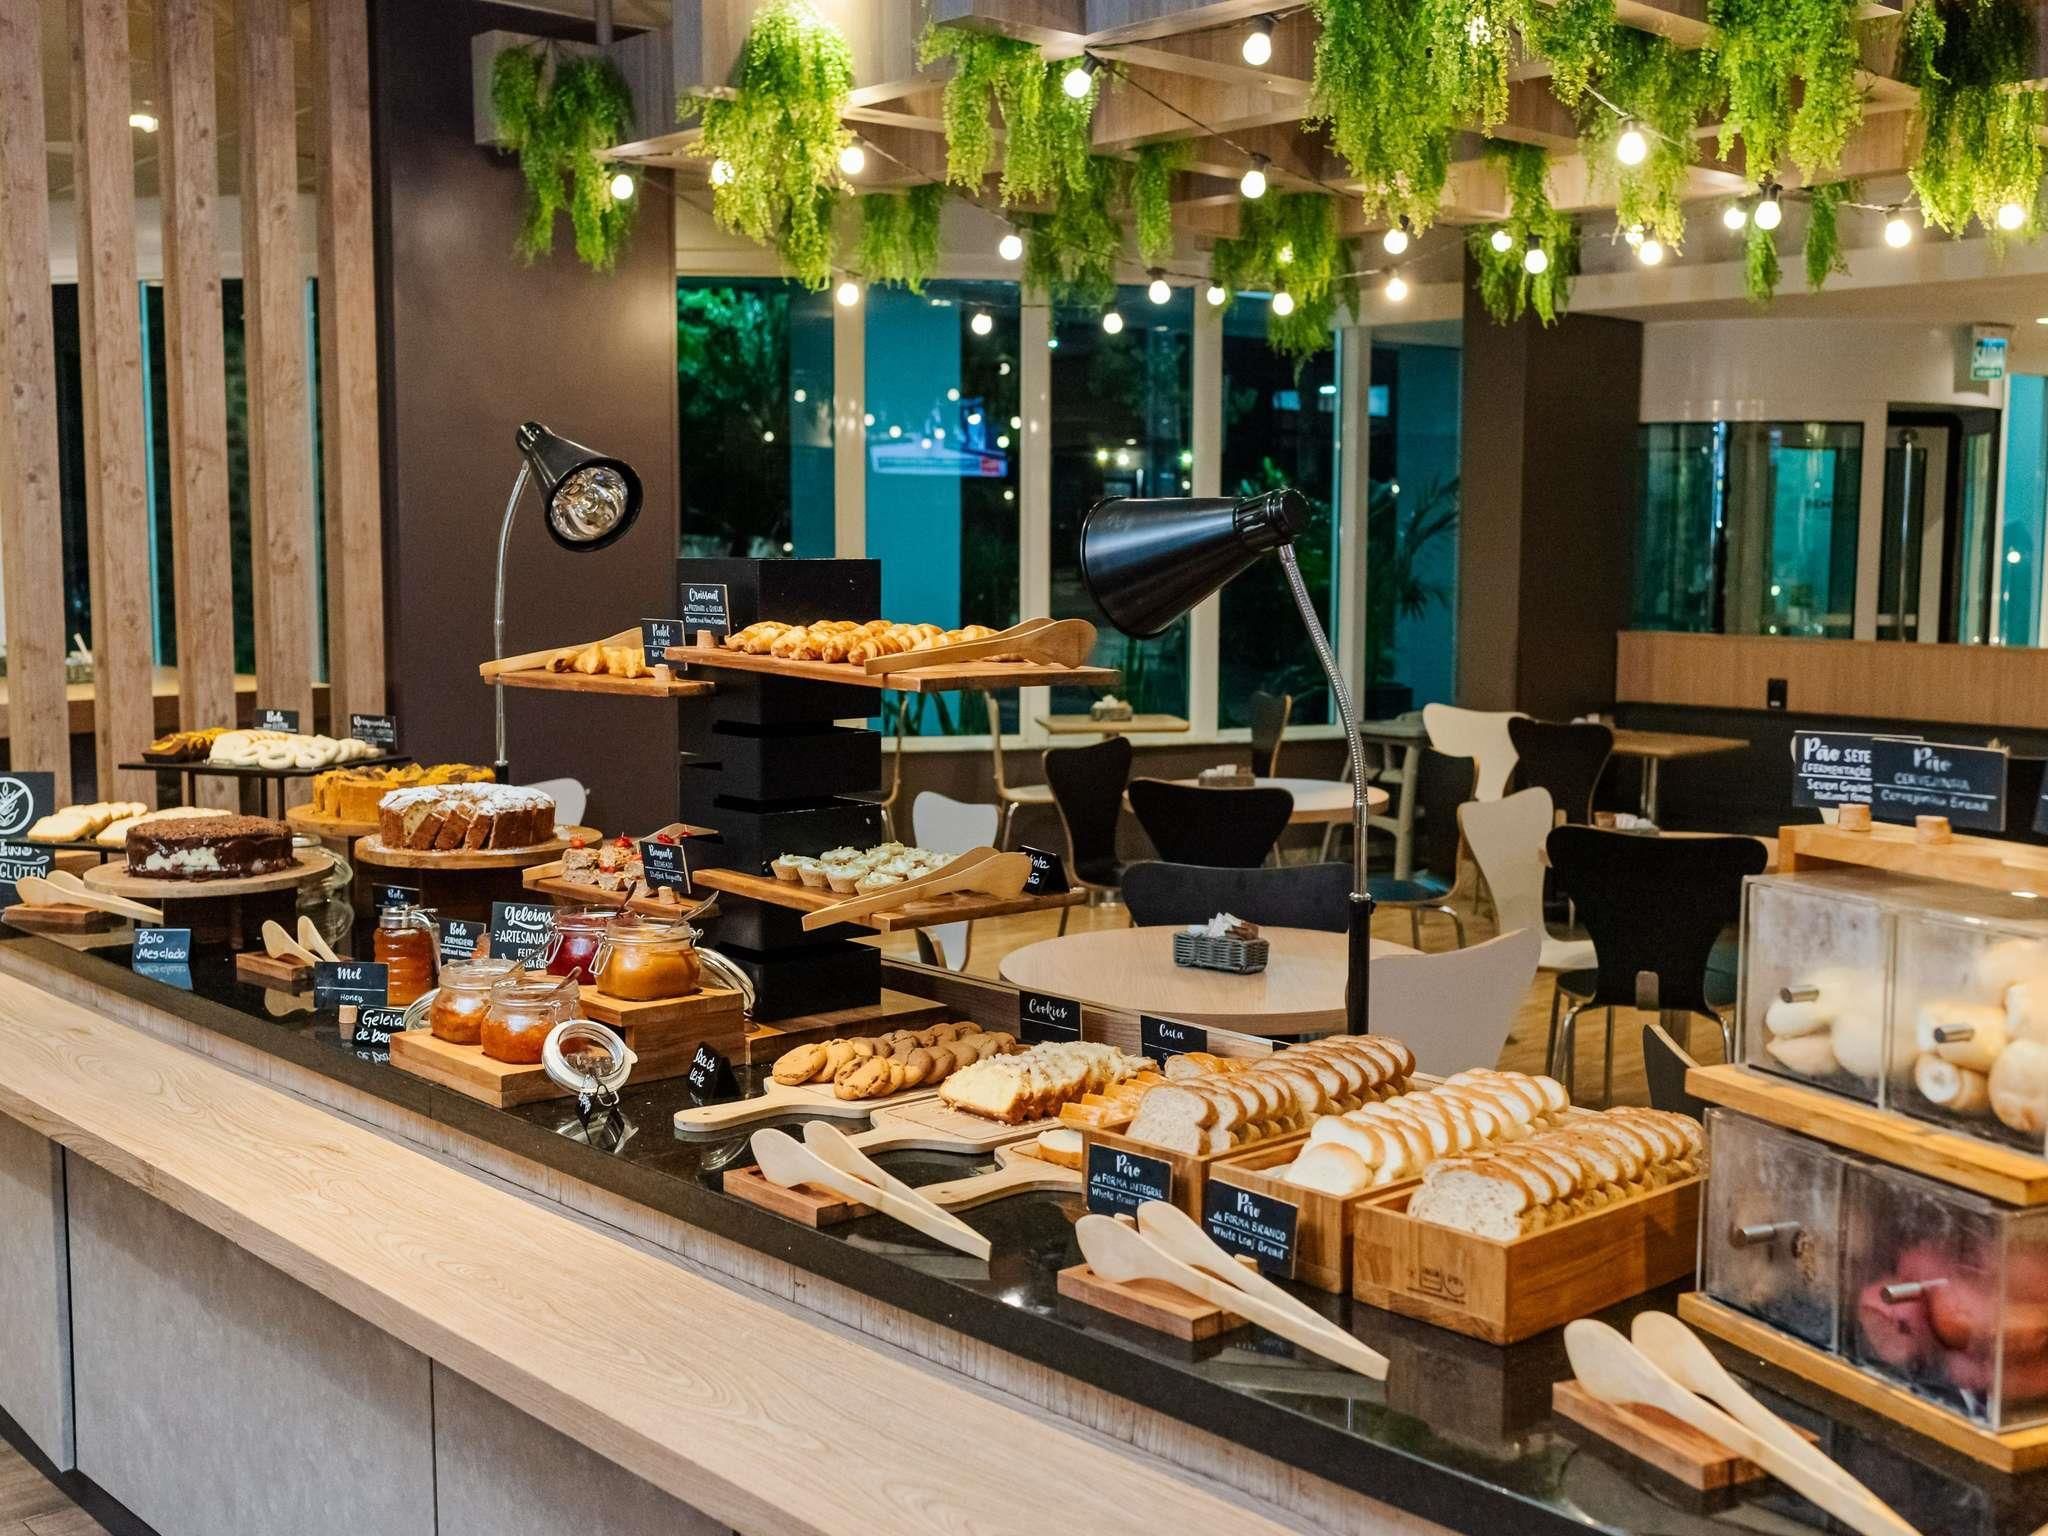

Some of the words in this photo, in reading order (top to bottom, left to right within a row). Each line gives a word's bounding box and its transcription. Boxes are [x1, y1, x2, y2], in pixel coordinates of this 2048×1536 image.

[1804, 737, 1840, 762] Pão
[450, 921, 467, 936] Bolo
[138, 931, 165, 945] Bolo
[136, 947, 187, 960] Mesclado
[337, 966, 362, 980] Mel
[340, 993, 364, 1004] Honey
[1028, 998, 1068, 1021] Cookies
[362, 1009, 405, 1027] Geleia
[355, 1028, 370, 1041] de
[1102, 1173, 1128, 1190] FORMA
[1223, 1211, 1250, 1230] FORMA
